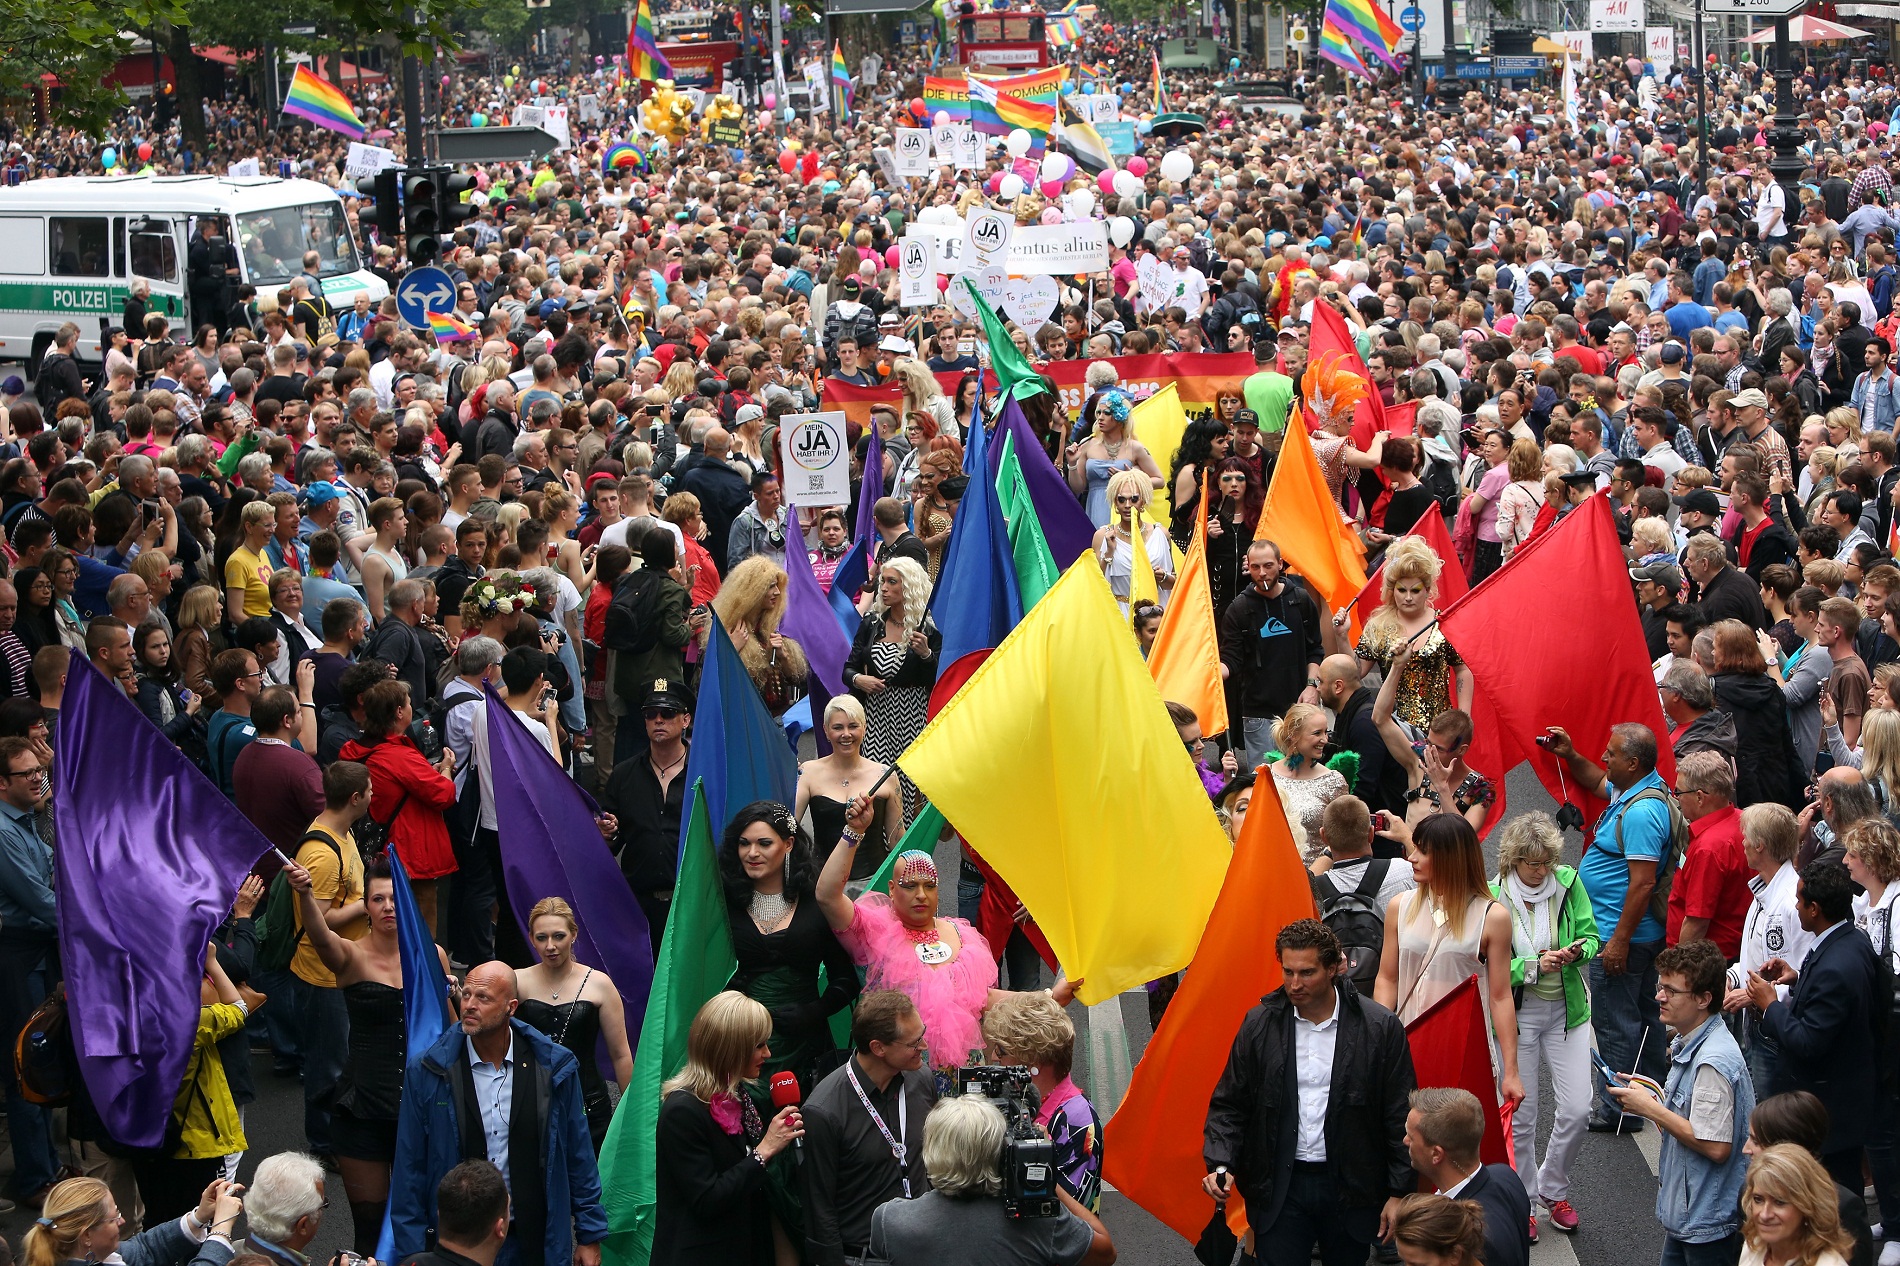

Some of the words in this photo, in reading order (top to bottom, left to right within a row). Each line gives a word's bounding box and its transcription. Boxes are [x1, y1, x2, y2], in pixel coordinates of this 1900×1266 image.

[1456, 65, 1525, 76] urfürstedamm
[926, 88, 945, 100] DIE
[950, 90, 970, 102] LES
[1099, 101, 1111, 111] JA
[940, 132, 953, 141] JA
[963, 133, 978, 143] JA
[904, 137, 920, 148] JA
[977, 222, 999, 240] JA
[1064, 236, 1103, 252] alius
[907, 248, 923, 265] JA
[321, 279, 361, 291] LIZEI
[53, 289, 108, 309] POLIZEI
[1006, 292, 1016, 301] To
[1020, 292, 1033, 303] jest
[798, 430, 831, 451] JA
[796, 450, 817, 458] HABT
[777, 1078, 794, 1087] rbb
